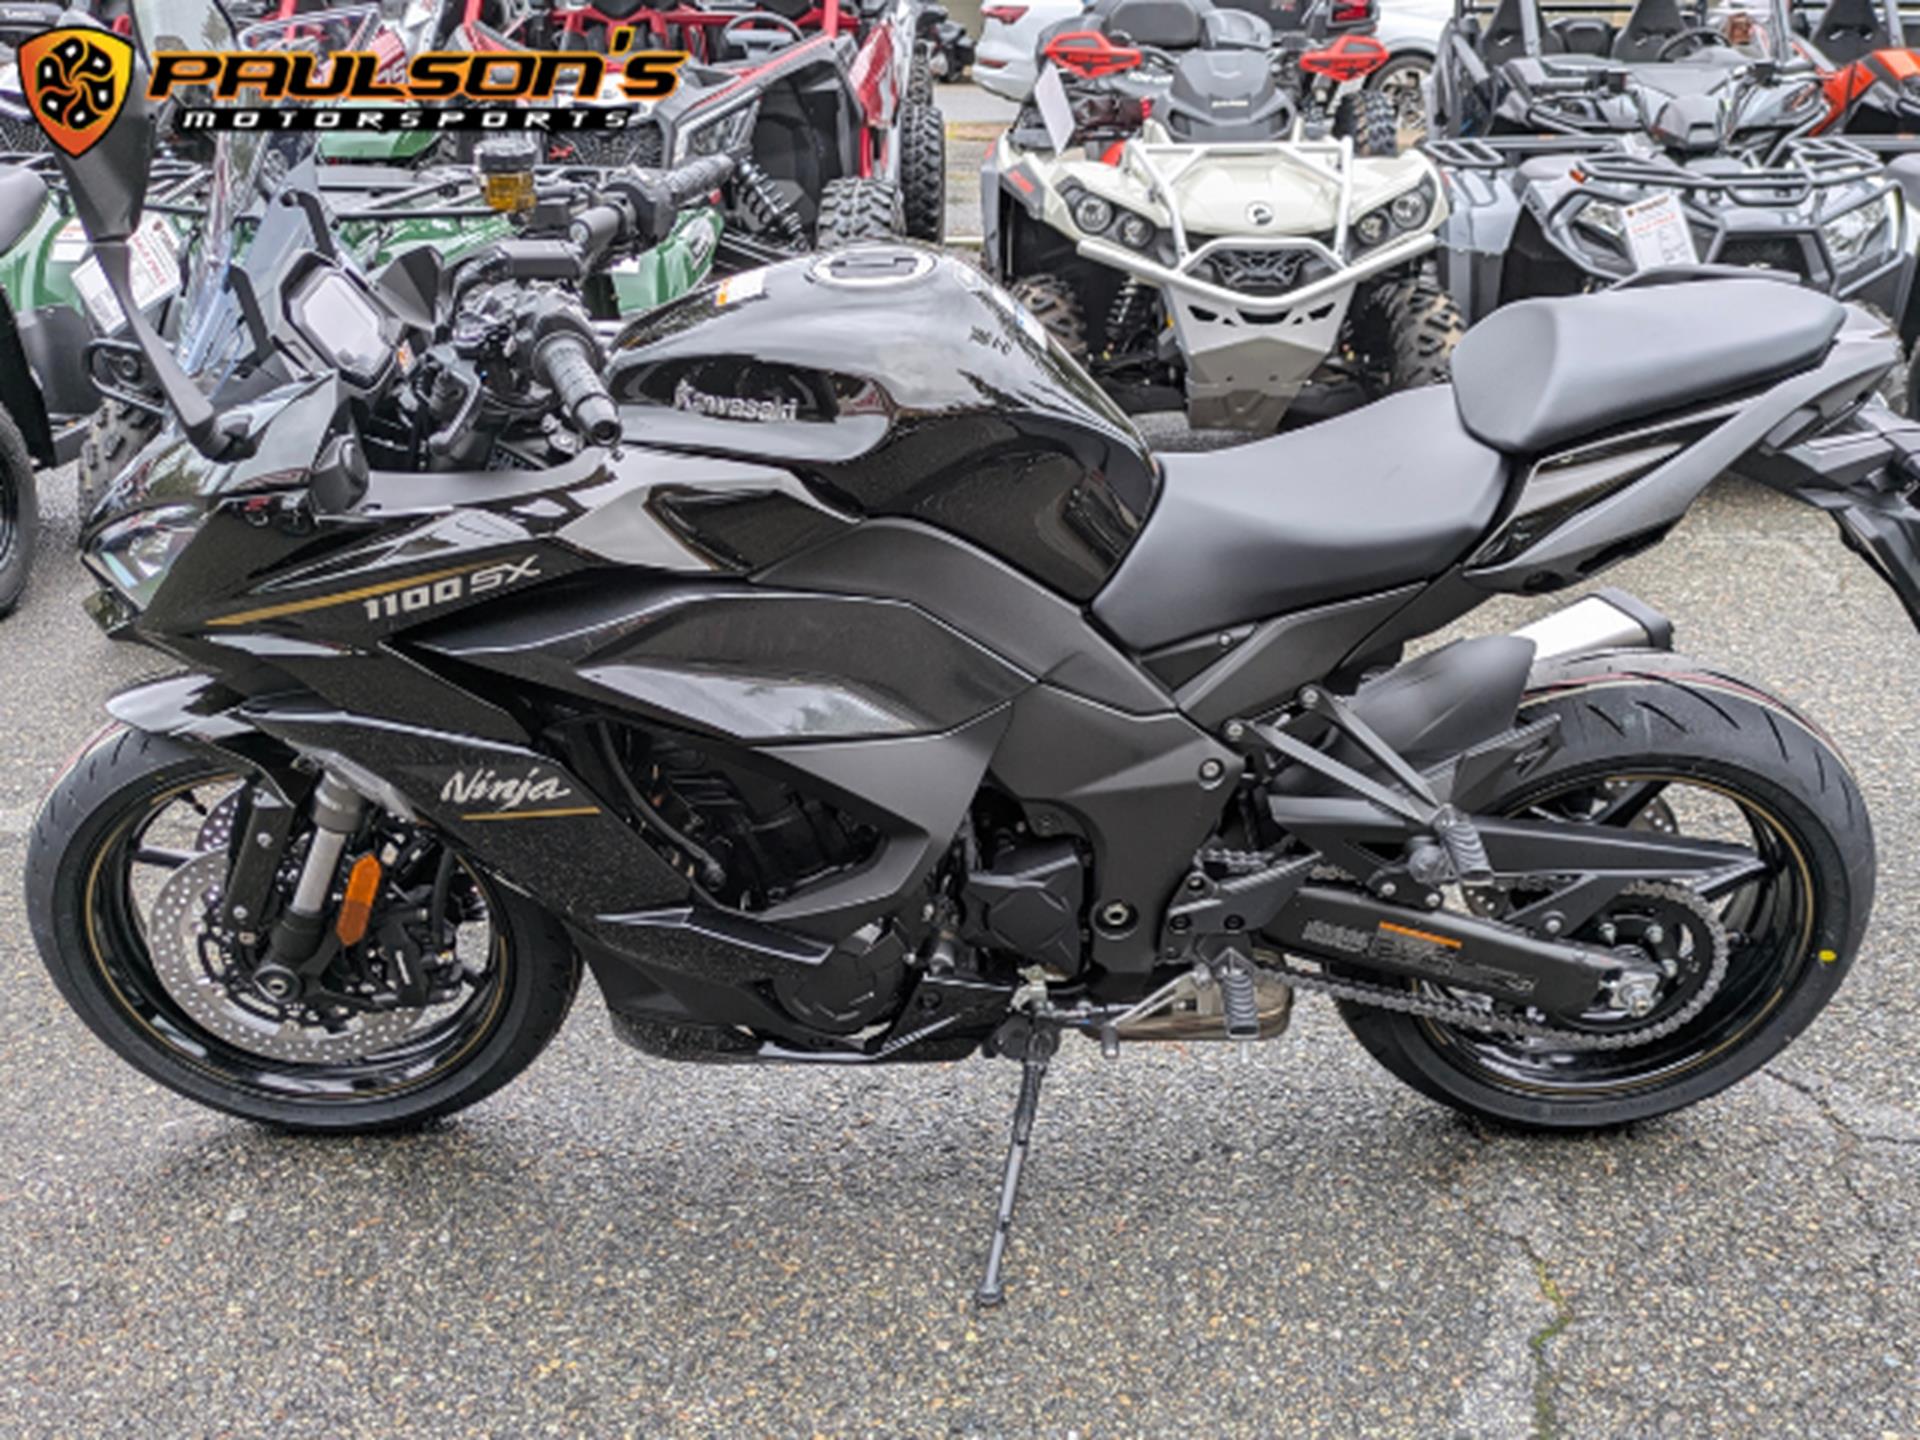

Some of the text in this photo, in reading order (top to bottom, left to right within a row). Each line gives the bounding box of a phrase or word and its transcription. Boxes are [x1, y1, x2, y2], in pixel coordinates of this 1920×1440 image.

[674, 378, 798, 421] Kawasaki
[363, 554, 541, 620] 1100 SX
[440, 767, 571, 811] Ninja
